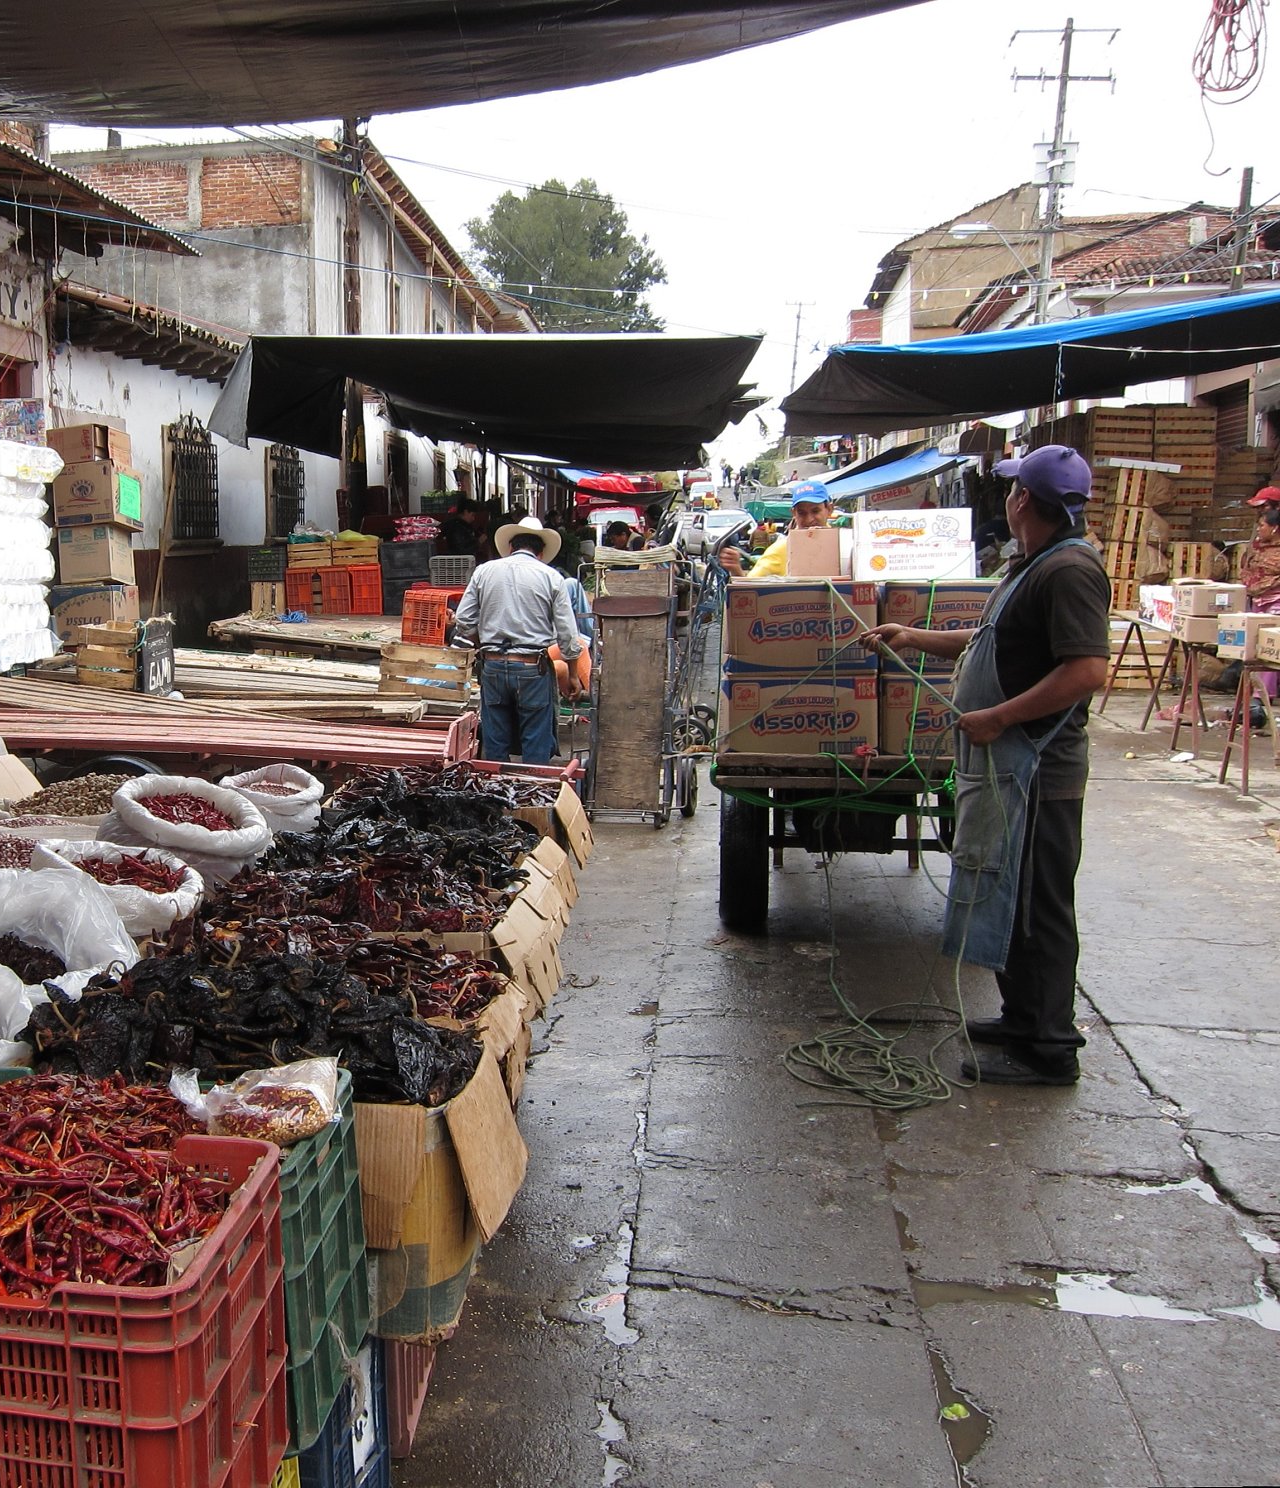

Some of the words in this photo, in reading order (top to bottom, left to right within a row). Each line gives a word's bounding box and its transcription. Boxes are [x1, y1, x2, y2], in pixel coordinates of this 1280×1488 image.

[871, 486, 912, 503] CREMERIA
[855, 586, 876, 602] 1654
[750, 617, 856, 641] ASSORTED
[857, 682, 877, 696] 1654
[752, 710, 858, 733] ASSORTED
